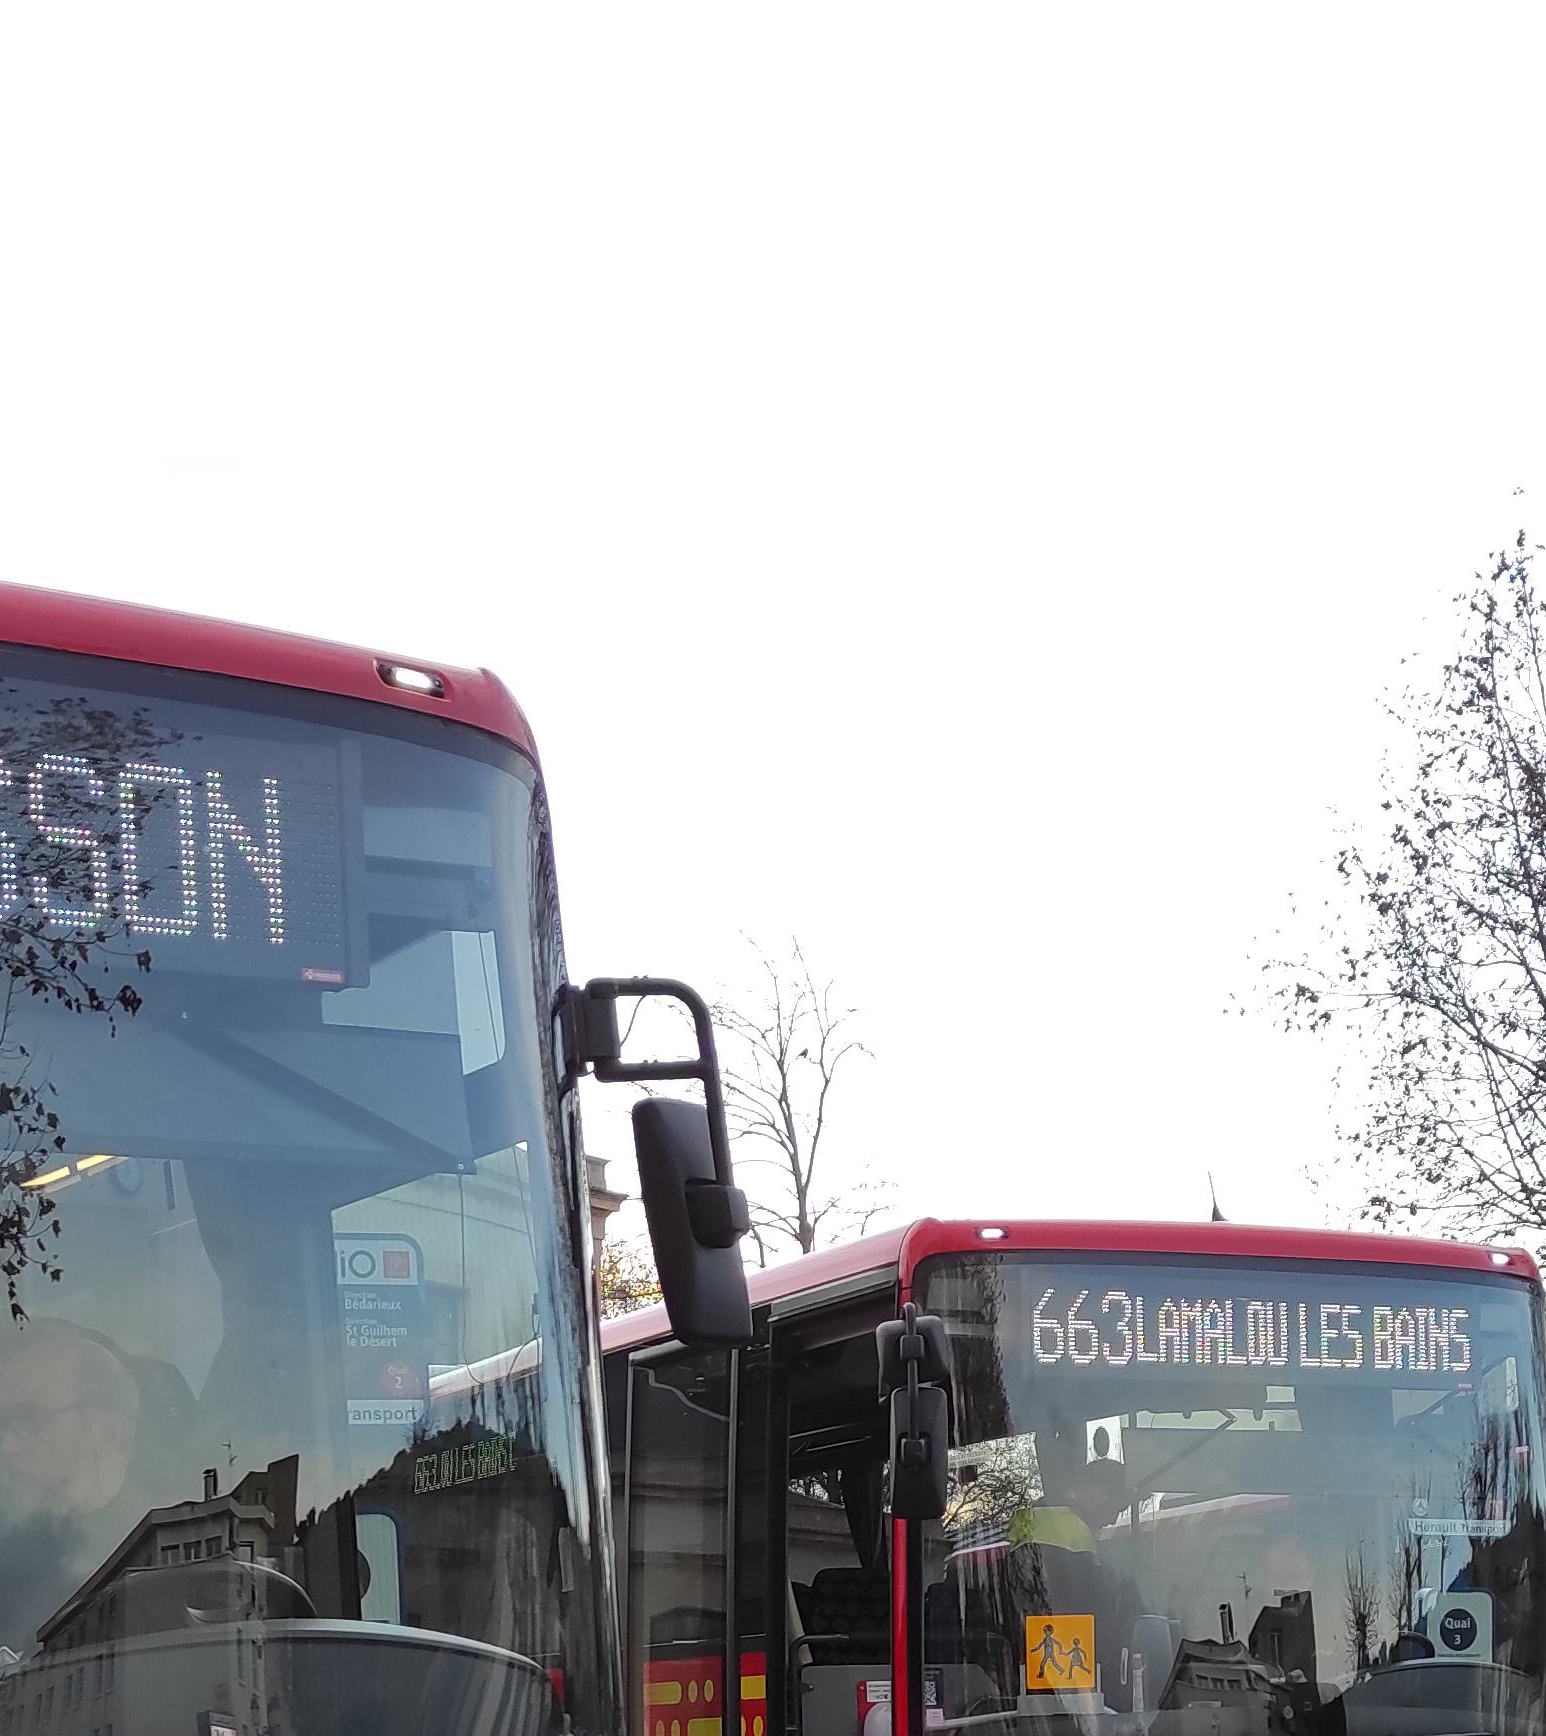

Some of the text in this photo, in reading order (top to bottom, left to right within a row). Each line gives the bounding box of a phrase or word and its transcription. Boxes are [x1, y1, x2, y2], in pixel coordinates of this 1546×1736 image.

[346, 1325, 407, 1336] St Guilhem
[1031, 1288, 1473, 1373] 663 LAMALOU LES BAINS
[1445, 1617, 1471, 1629] Quai
[1453, 1635, 1461, 1645] 3
